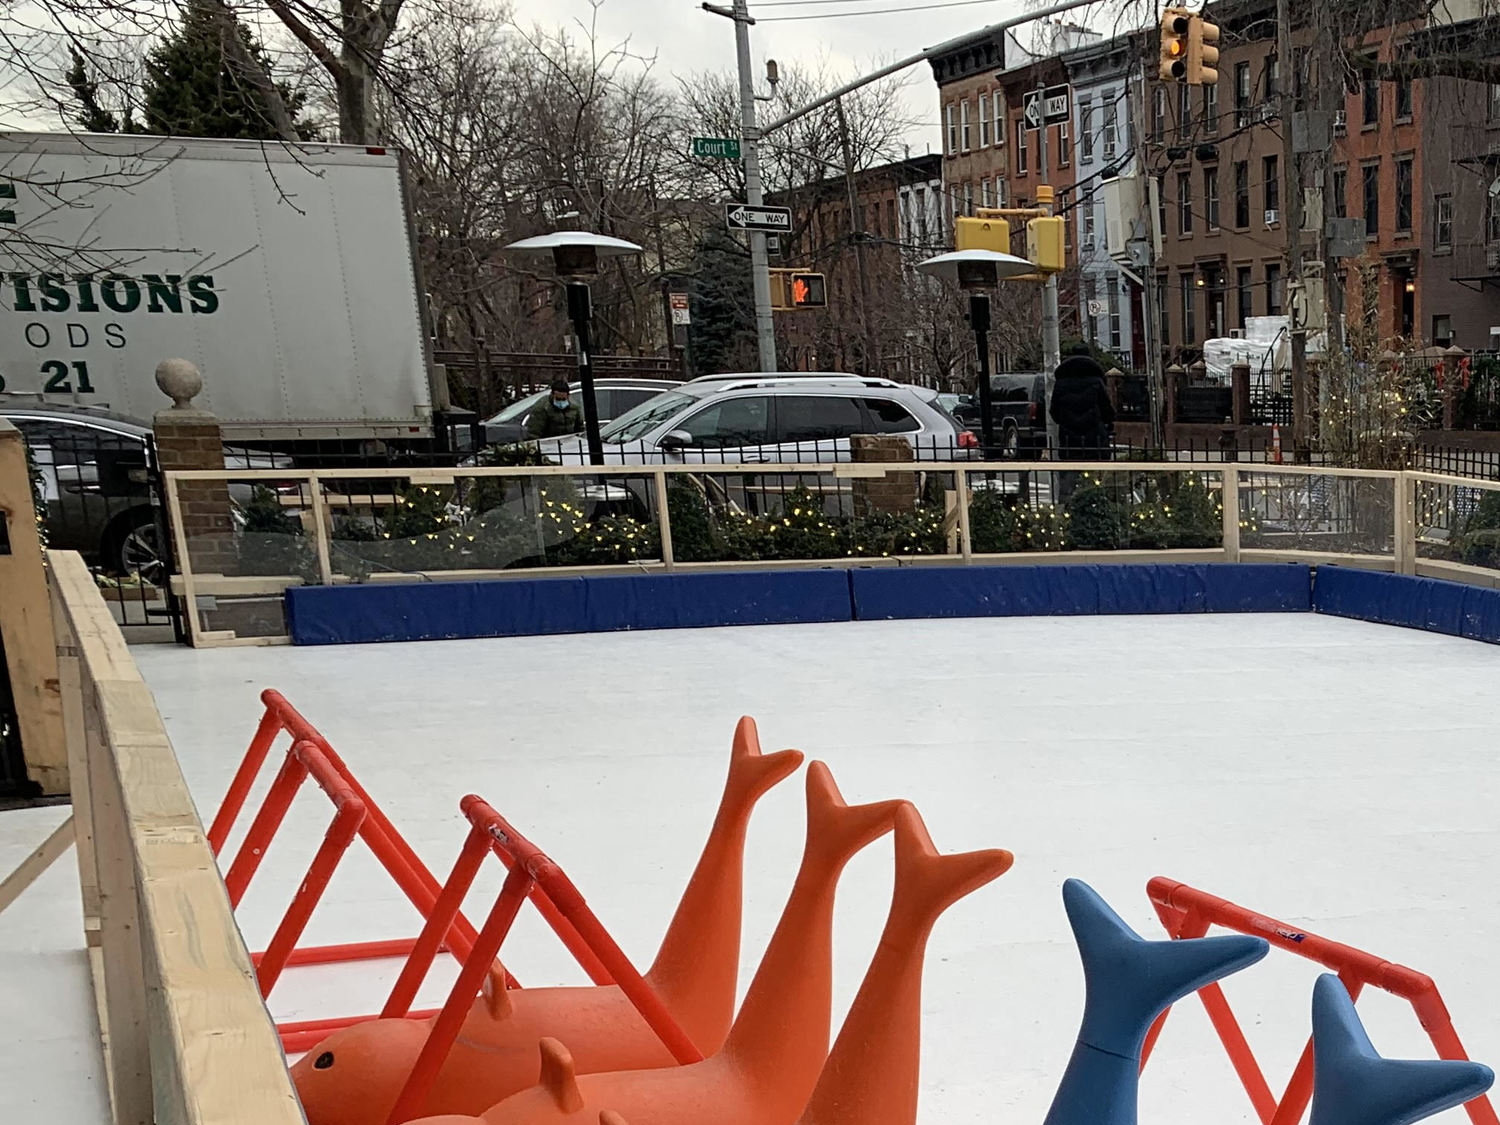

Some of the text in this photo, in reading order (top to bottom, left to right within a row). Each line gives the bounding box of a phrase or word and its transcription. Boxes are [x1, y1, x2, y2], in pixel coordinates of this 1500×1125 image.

[1050, 97, 1065, 113] WAY
[696, 139, 739, 155] Court St
[734, 211, 785, 224] ONE WAY
[0, 271, 219, 314] ISIONS
[40, 360, 95, 394] 21
